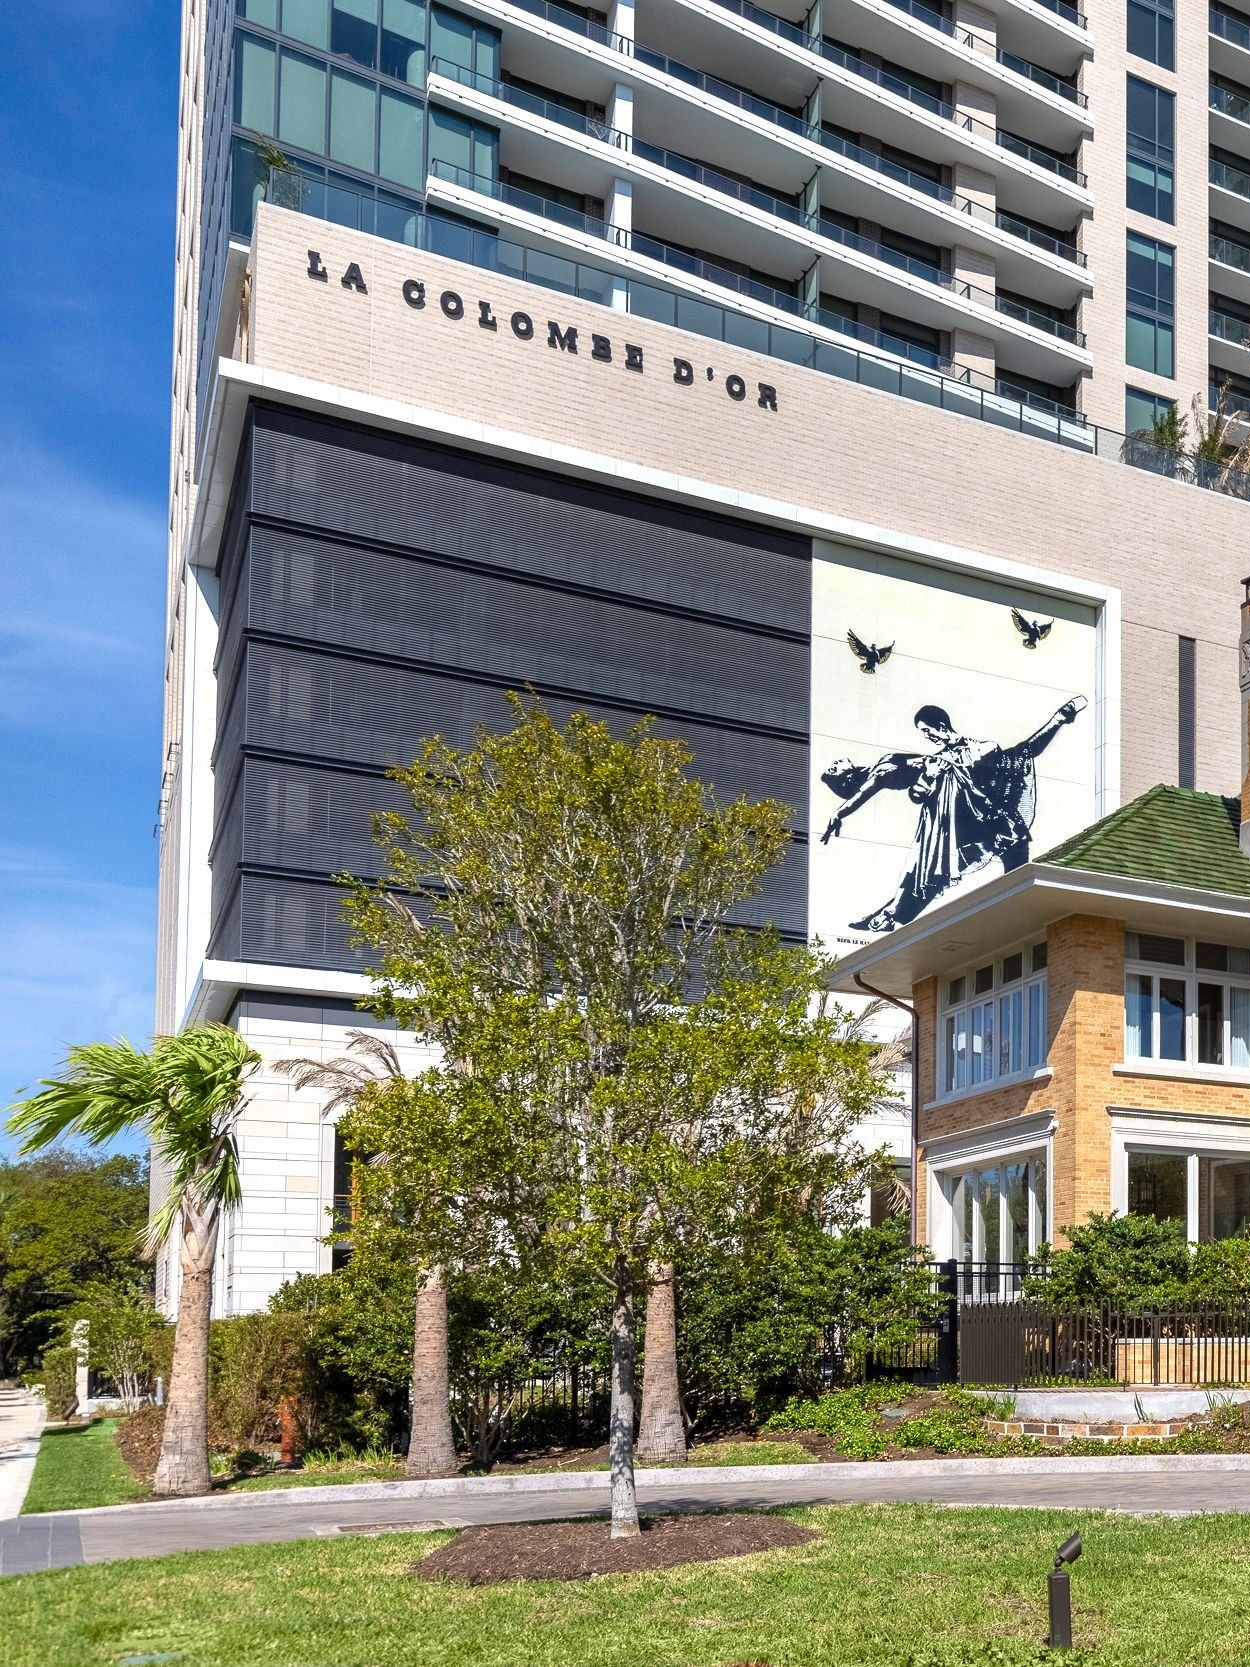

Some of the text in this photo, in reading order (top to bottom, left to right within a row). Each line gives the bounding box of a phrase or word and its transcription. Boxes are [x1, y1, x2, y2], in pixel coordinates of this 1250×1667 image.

[307, 249, 778, 413] LA COLOMBE D'OR
